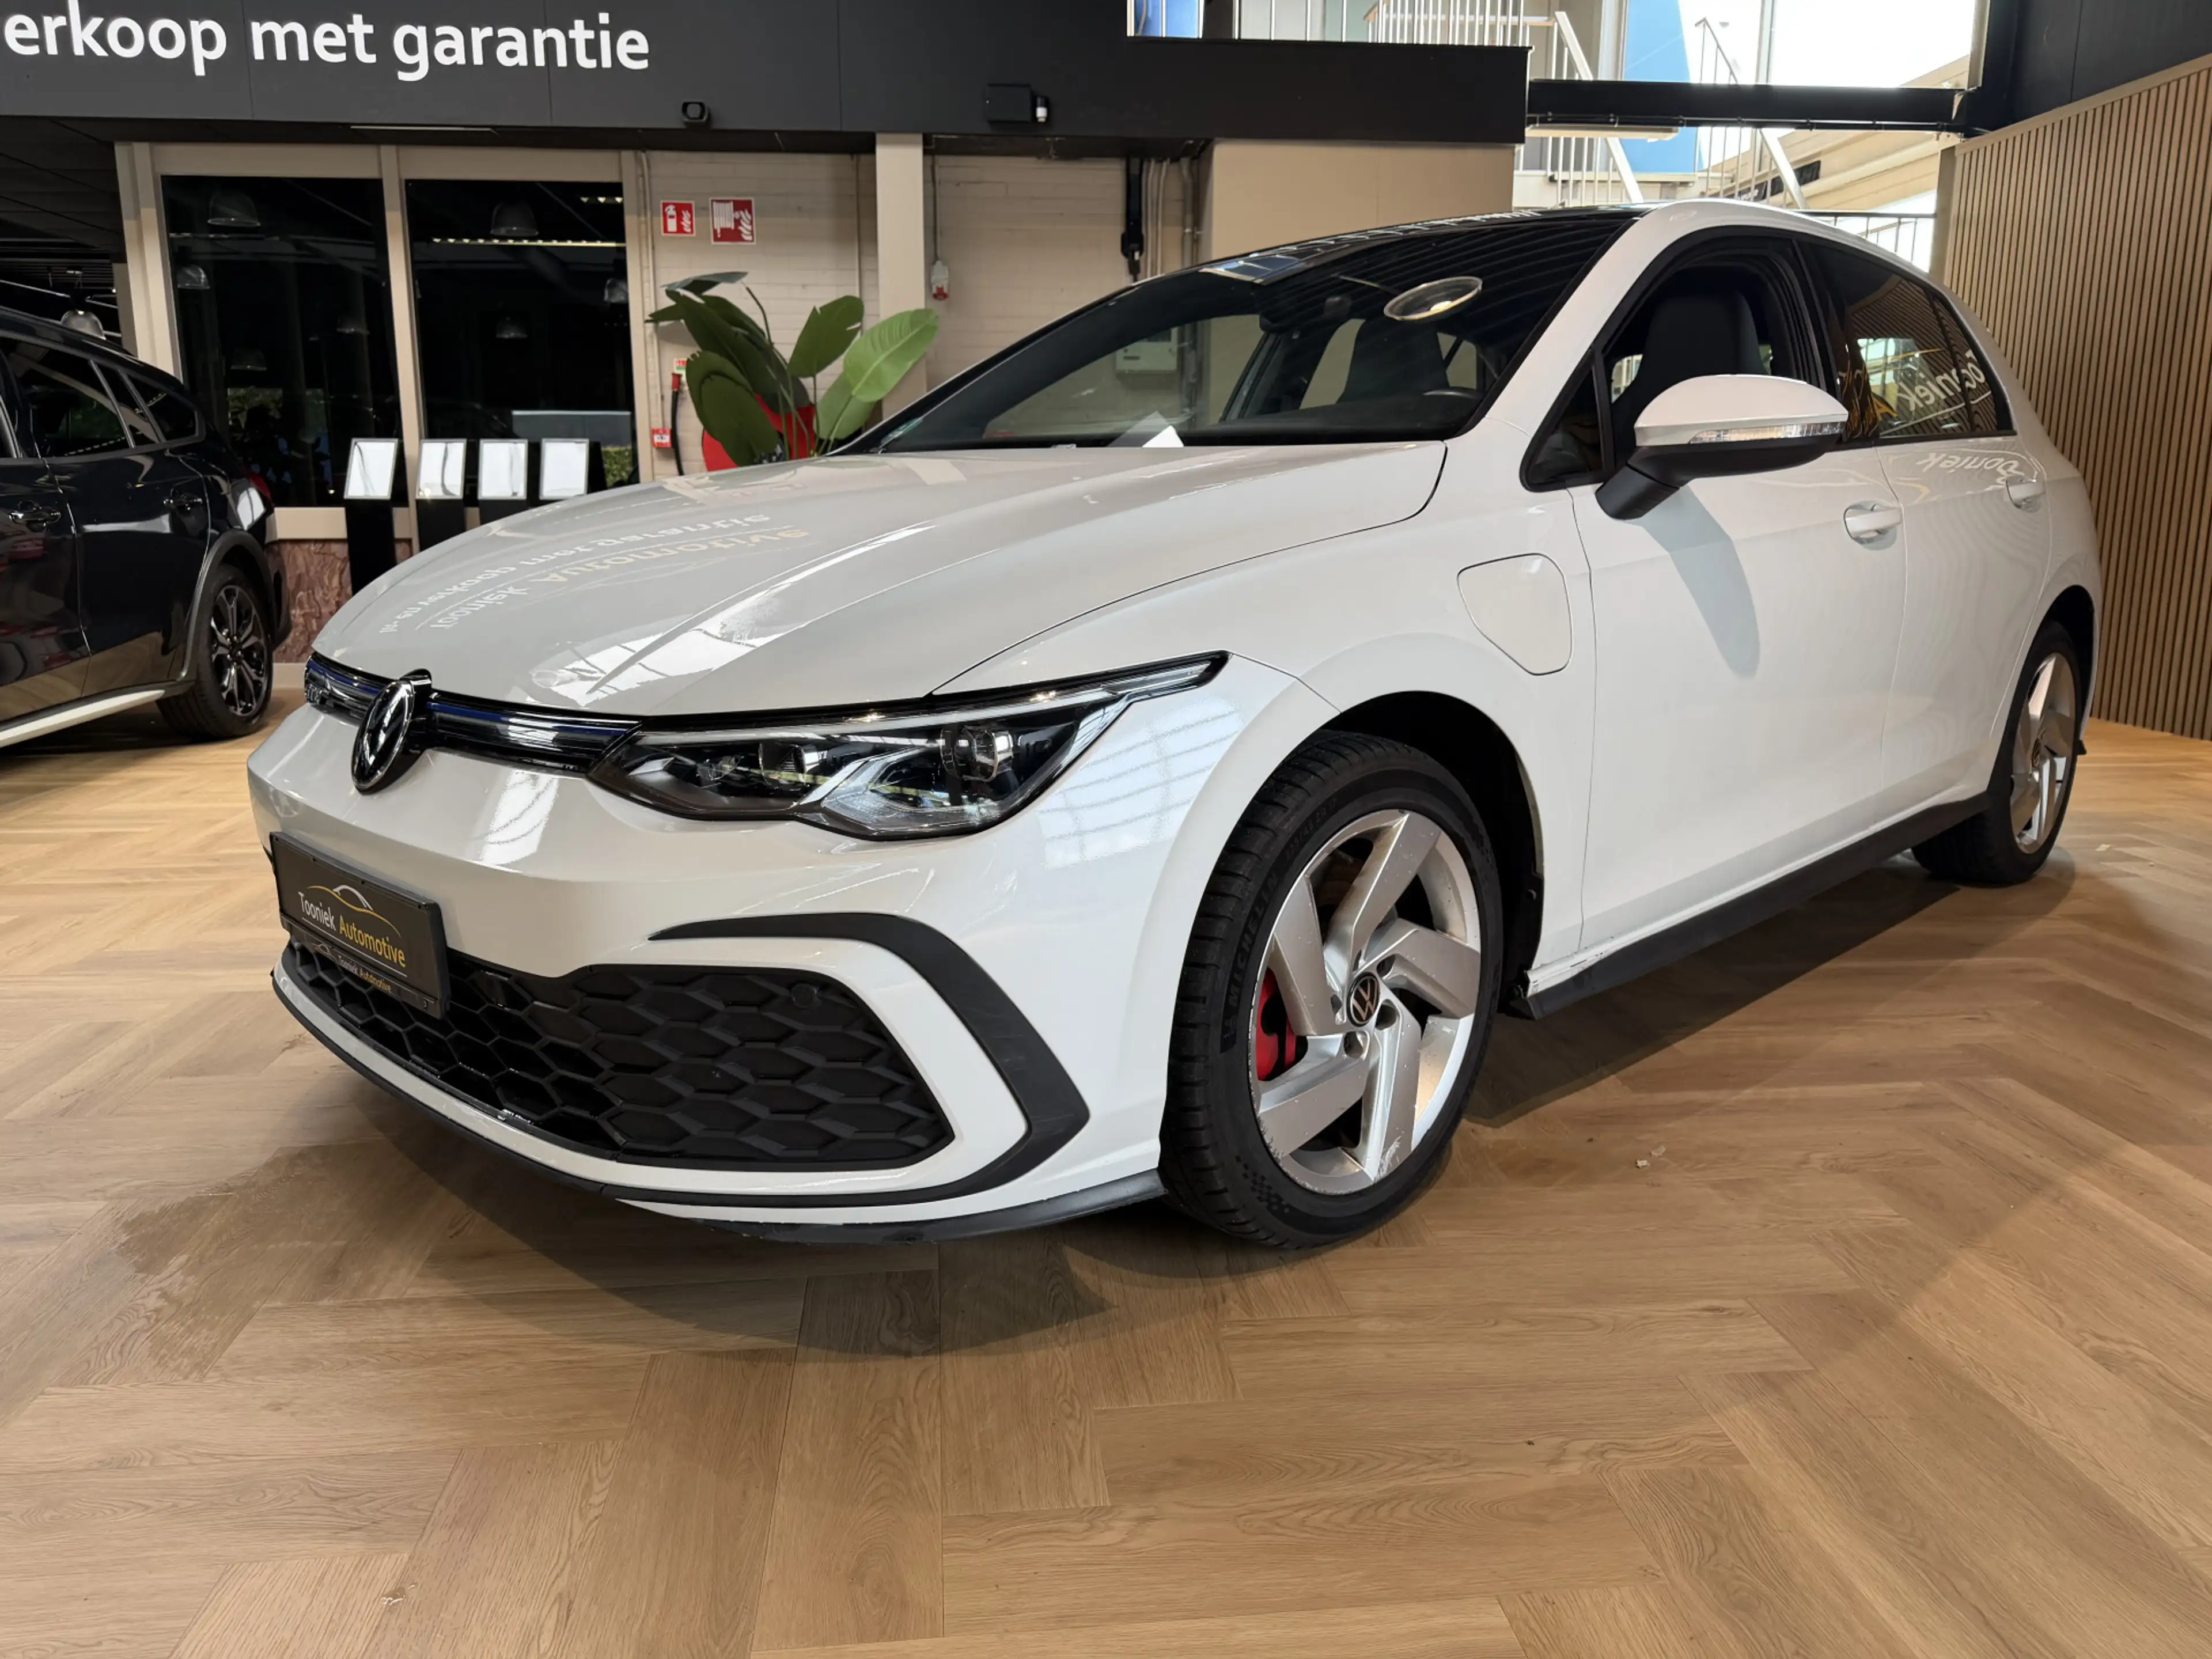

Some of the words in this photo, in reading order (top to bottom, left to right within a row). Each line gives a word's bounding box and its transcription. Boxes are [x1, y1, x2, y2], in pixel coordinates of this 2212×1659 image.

[5, 0, 227, 75] erkoop
[251, 14, 376, 63] met
[393, 13, 649, 81] garantie
[298, 892, 336, 931] Tooniek
[340, 915, 406, 967] Automotive
[1229, 873, 1278, 1006] MICHELIN
